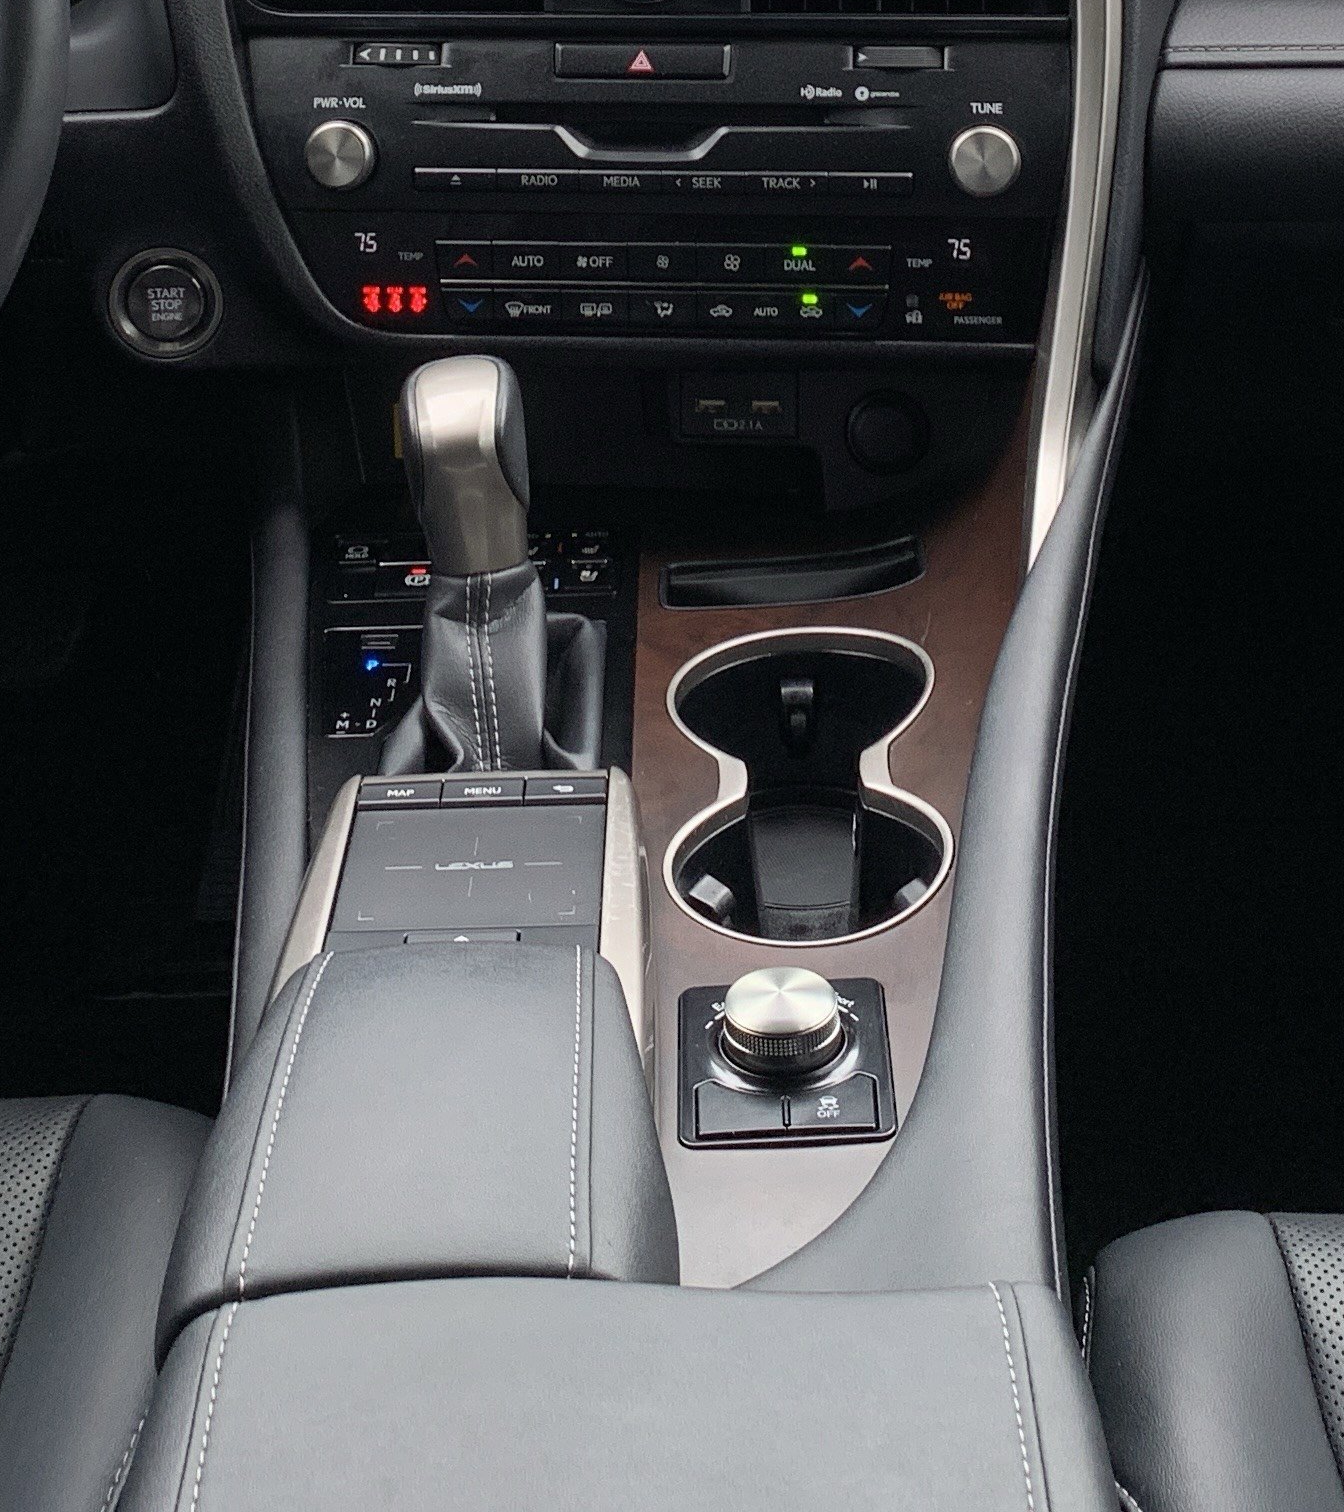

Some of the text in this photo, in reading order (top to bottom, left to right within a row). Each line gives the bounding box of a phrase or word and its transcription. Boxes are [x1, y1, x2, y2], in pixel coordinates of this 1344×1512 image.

[815, 86, 843, 98] Radio
[970, 102, 1003, 115] TUNE
[521, 175, 558, 187] RADIO
[603, 175, 640, 188] MEDIA
[692, 177, 801, 189] SEEK TRACK
[355, 232, 377, 253] 75
[947, 238, 971, 260] 75
[398, 251, 424, 262] TEMP
[511, 255, 544, 268] AUTO
[589, 256, 613, 268] OFF
[783, 259, 816, 272] DUAL
[906, 257, 932, 268] TEMP
[147, 288, 186, 299] START
[151, 299, 182, 310] STOP
[523, 303, 551, 315] FRONT
[753, 306, 778, 317] AUTO
[152, 313, 183, 322] ENGINE
[954, 315, 1003, 325] PASSENGER
[367, 659, 379, 670] P
[387, 678, 397, 688] R
[370, 698, 382, 707] N
[336, 719, 350, 730] M
[365, 719, 378, 729] D
[387, 788, 415, 798] MAP
[463, 786, 502, 796] MENU
[435, 860, 514, 871] LEXUS
[817, 1109, 841, 1119] OFF
